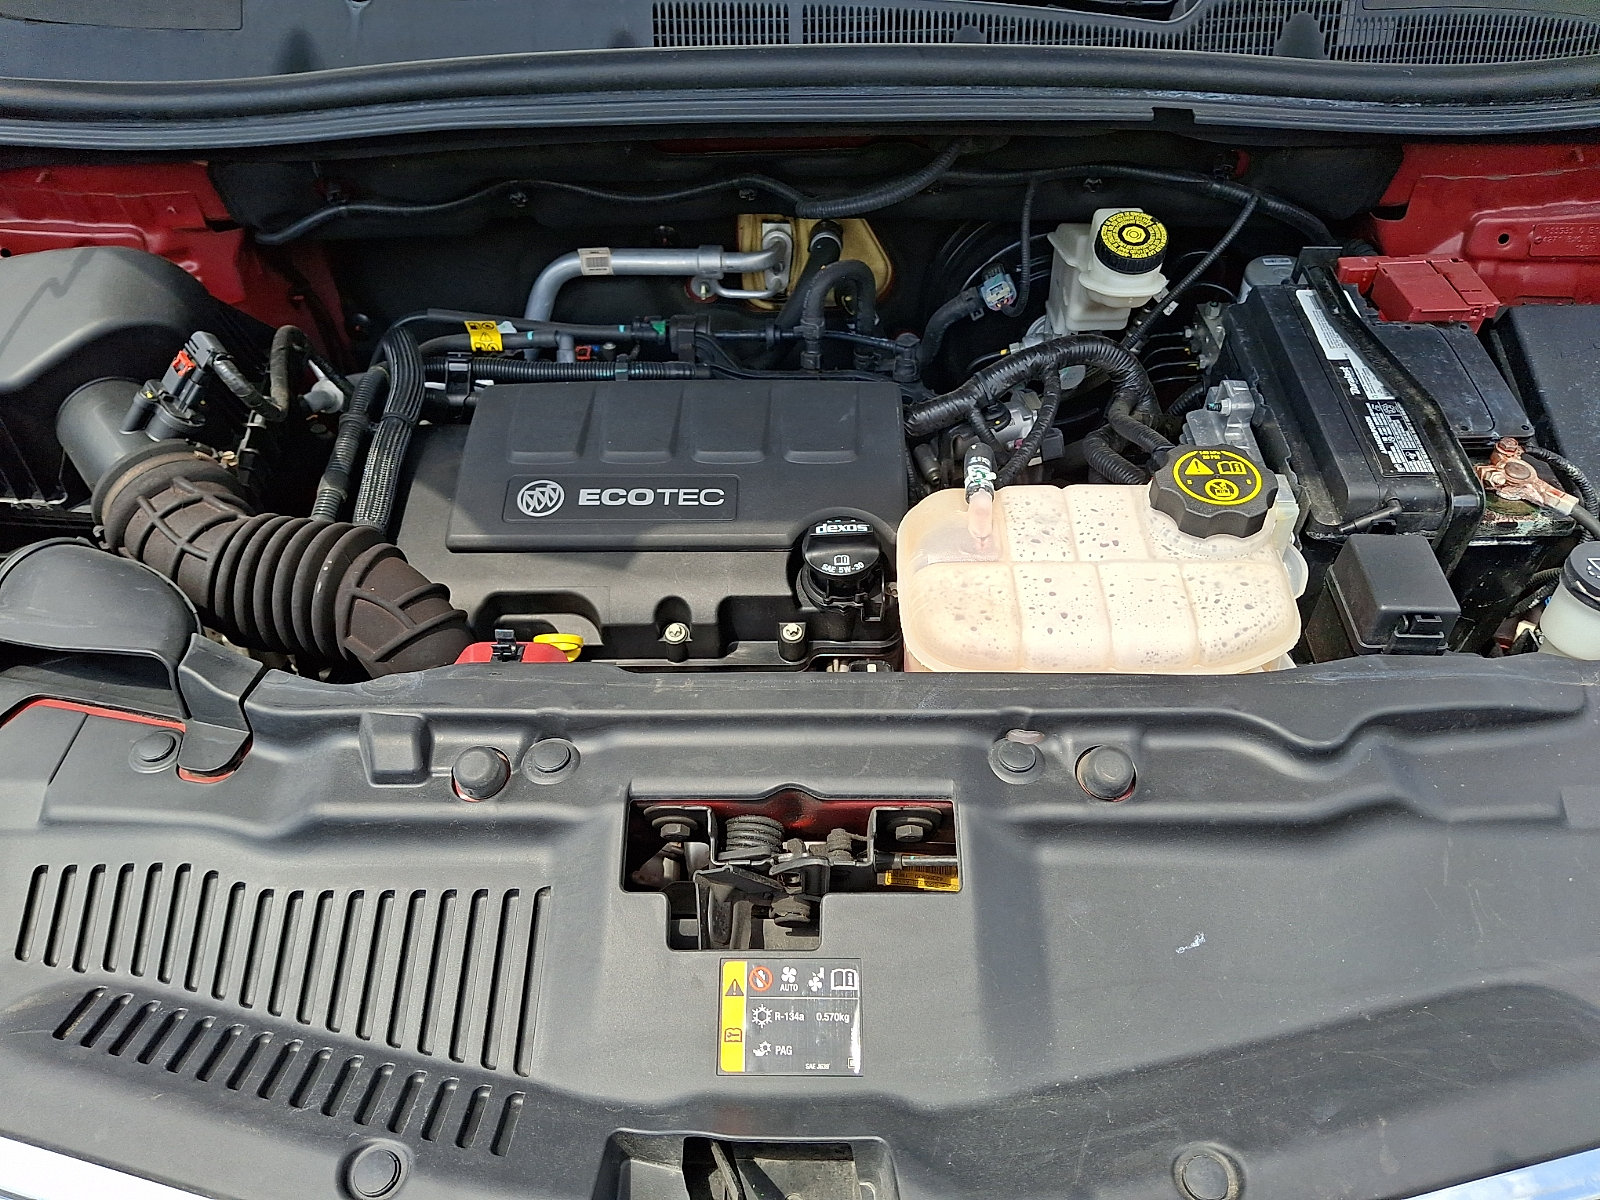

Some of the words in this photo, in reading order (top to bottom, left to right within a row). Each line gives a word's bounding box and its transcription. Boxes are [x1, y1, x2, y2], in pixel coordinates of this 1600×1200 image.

[578, 488, 725, 506] ECOTEC
[815, 523, 870, 534] dexos
[821, 563, 836, 573] SAE
[838, 561, 865, 574] 5W-30
[780, 983, 799, 992] AUTO
[774, 1011, 805, 1021] R-134a
[816, 1012, 850, 1023] 0.570kg
[775, 1045, 793, 1056] PAG
